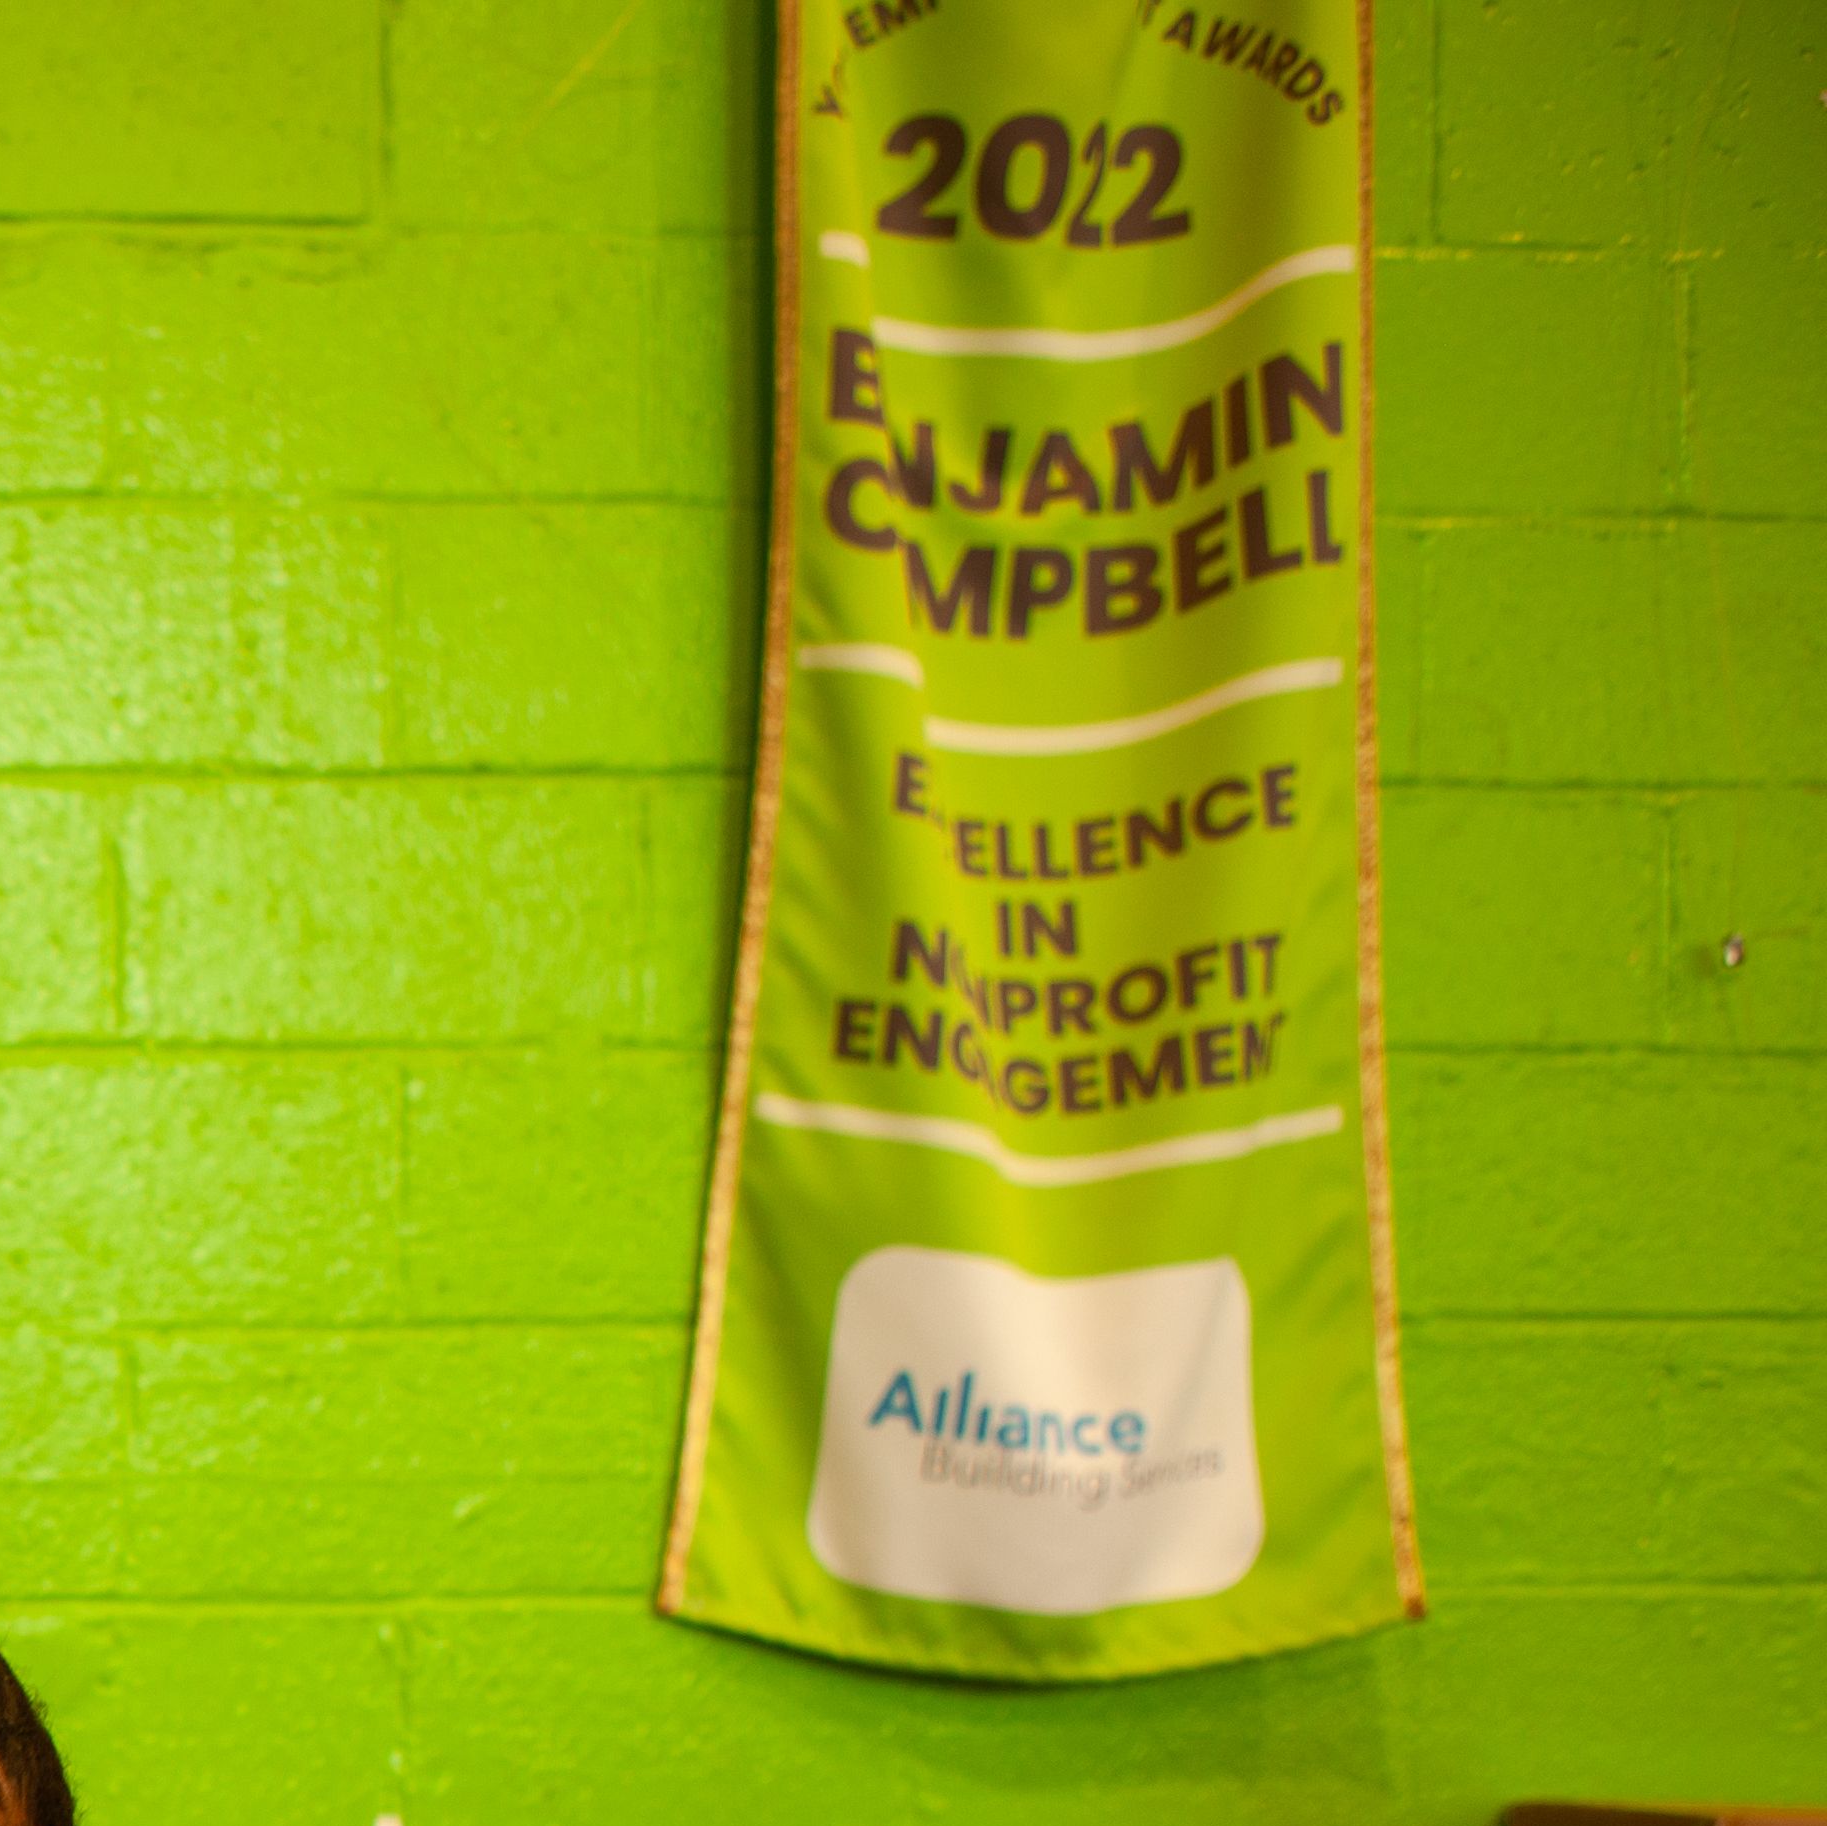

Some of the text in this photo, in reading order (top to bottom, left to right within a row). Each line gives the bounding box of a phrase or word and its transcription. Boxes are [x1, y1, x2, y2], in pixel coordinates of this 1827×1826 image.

[1163, 8, 1344, 128] AWARDS
[829, 326, 1345, 516] BNJAMIN
[822, 457, 1344, 641] CMPBELL
[893, 752, 1298, 881] EELLENCE
[997, 899, 1078, 958] IN
[868, 1368, 1146, 1455] Alliance
